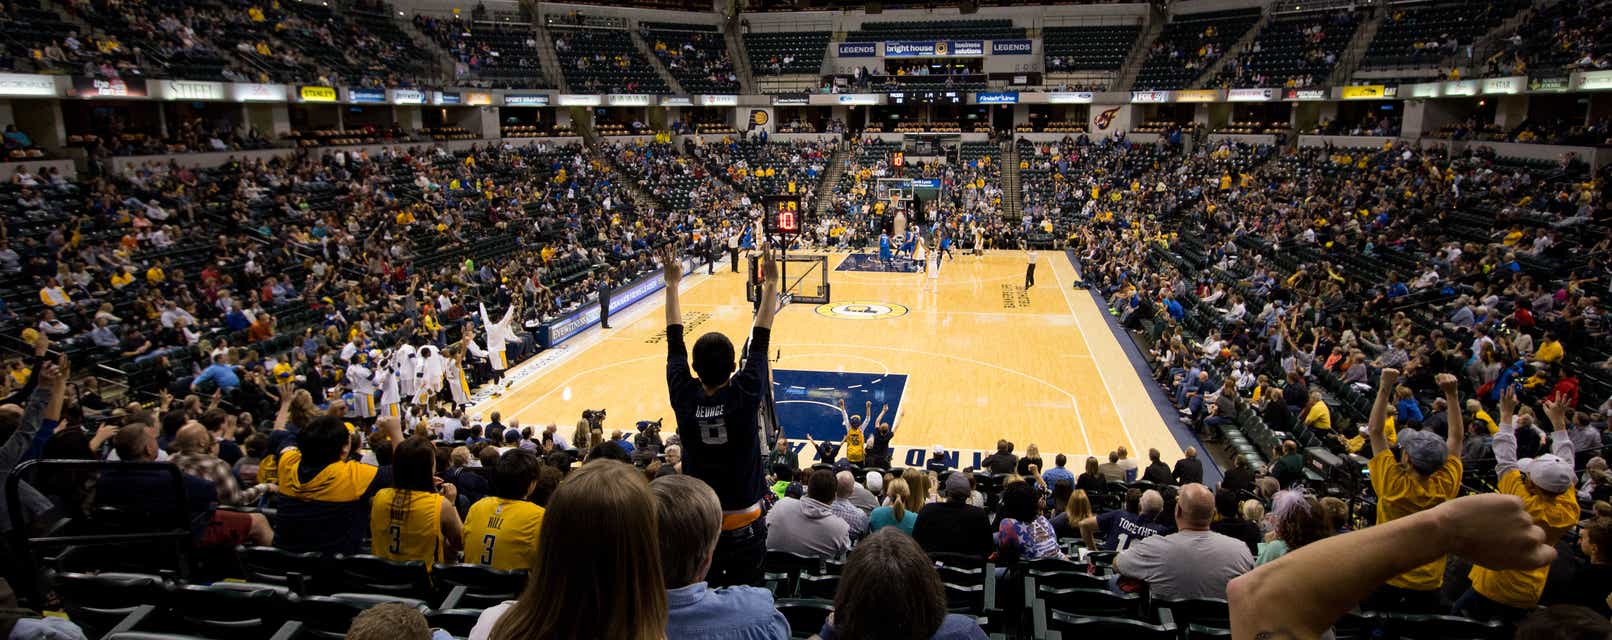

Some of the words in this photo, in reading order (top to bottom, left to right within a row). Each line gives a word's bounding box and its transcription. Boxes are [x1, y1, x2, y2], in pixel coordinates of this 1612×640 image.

[840, 46, 875, 54] LEGENDS
[887, 45, 909, 54] bright
[910, 45, 934, 53] house
[994, 43, 1030, 51] LEGENDS
[780, 212, 794, 229] 10
[695, 404, 724, 418] GEORGE
[488, 516, 505, 530] HILL
[389, 525, 401, 554] 3
[480, 533, 497, 565] 3
